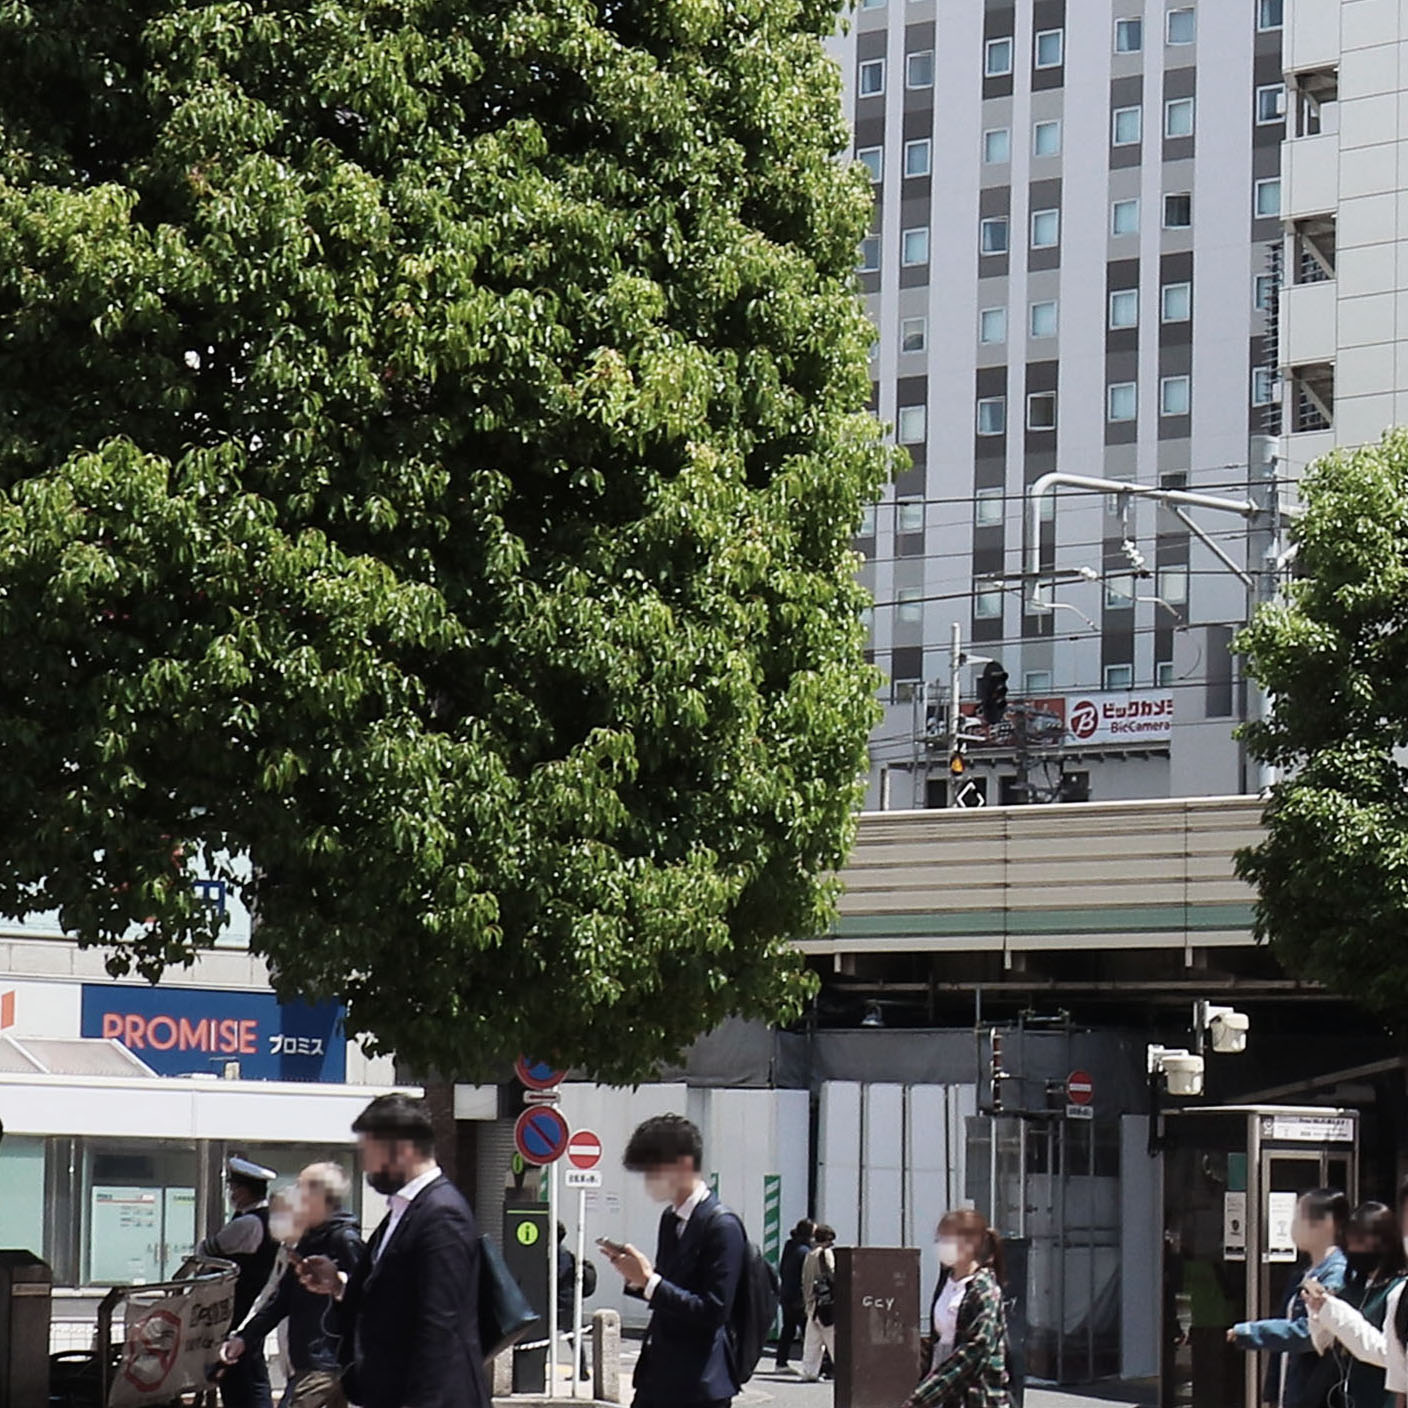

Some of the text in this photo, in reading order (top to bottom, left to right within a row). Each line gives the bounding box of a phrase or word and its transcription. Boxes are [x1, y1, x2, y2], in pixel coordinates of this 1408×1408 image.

[1111, 721, 1171, 734] BicCamera
[102, 1012, 258, 1054] PROMISE
[268, 1033, 325, 1055] プロミス
